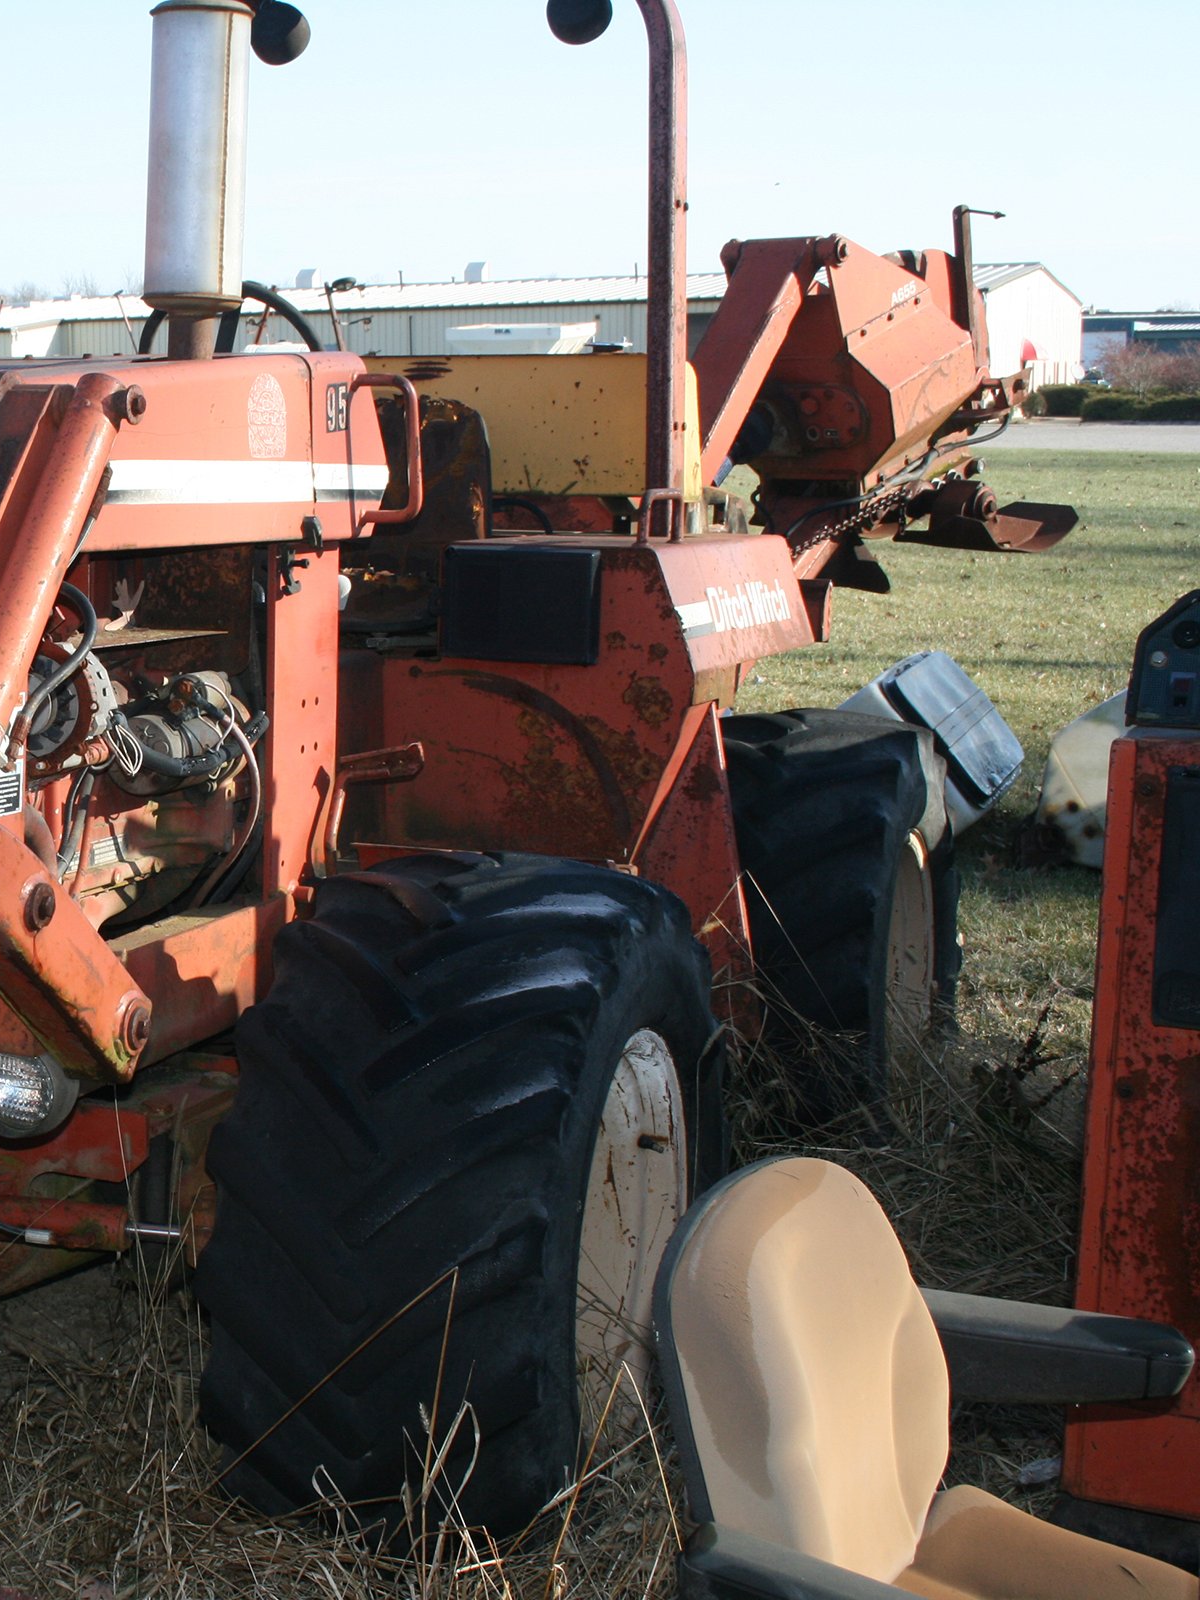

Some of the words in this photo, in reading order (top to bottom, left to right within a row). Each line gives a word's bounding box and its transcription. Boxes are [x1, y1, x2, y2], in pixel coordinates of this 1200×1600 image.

[891, 280, 917, 307] A655
[326, 385, 348, 432] 95
[706, 583, 752, 632] Ditch
[745, 579, 792, 626] Witch
